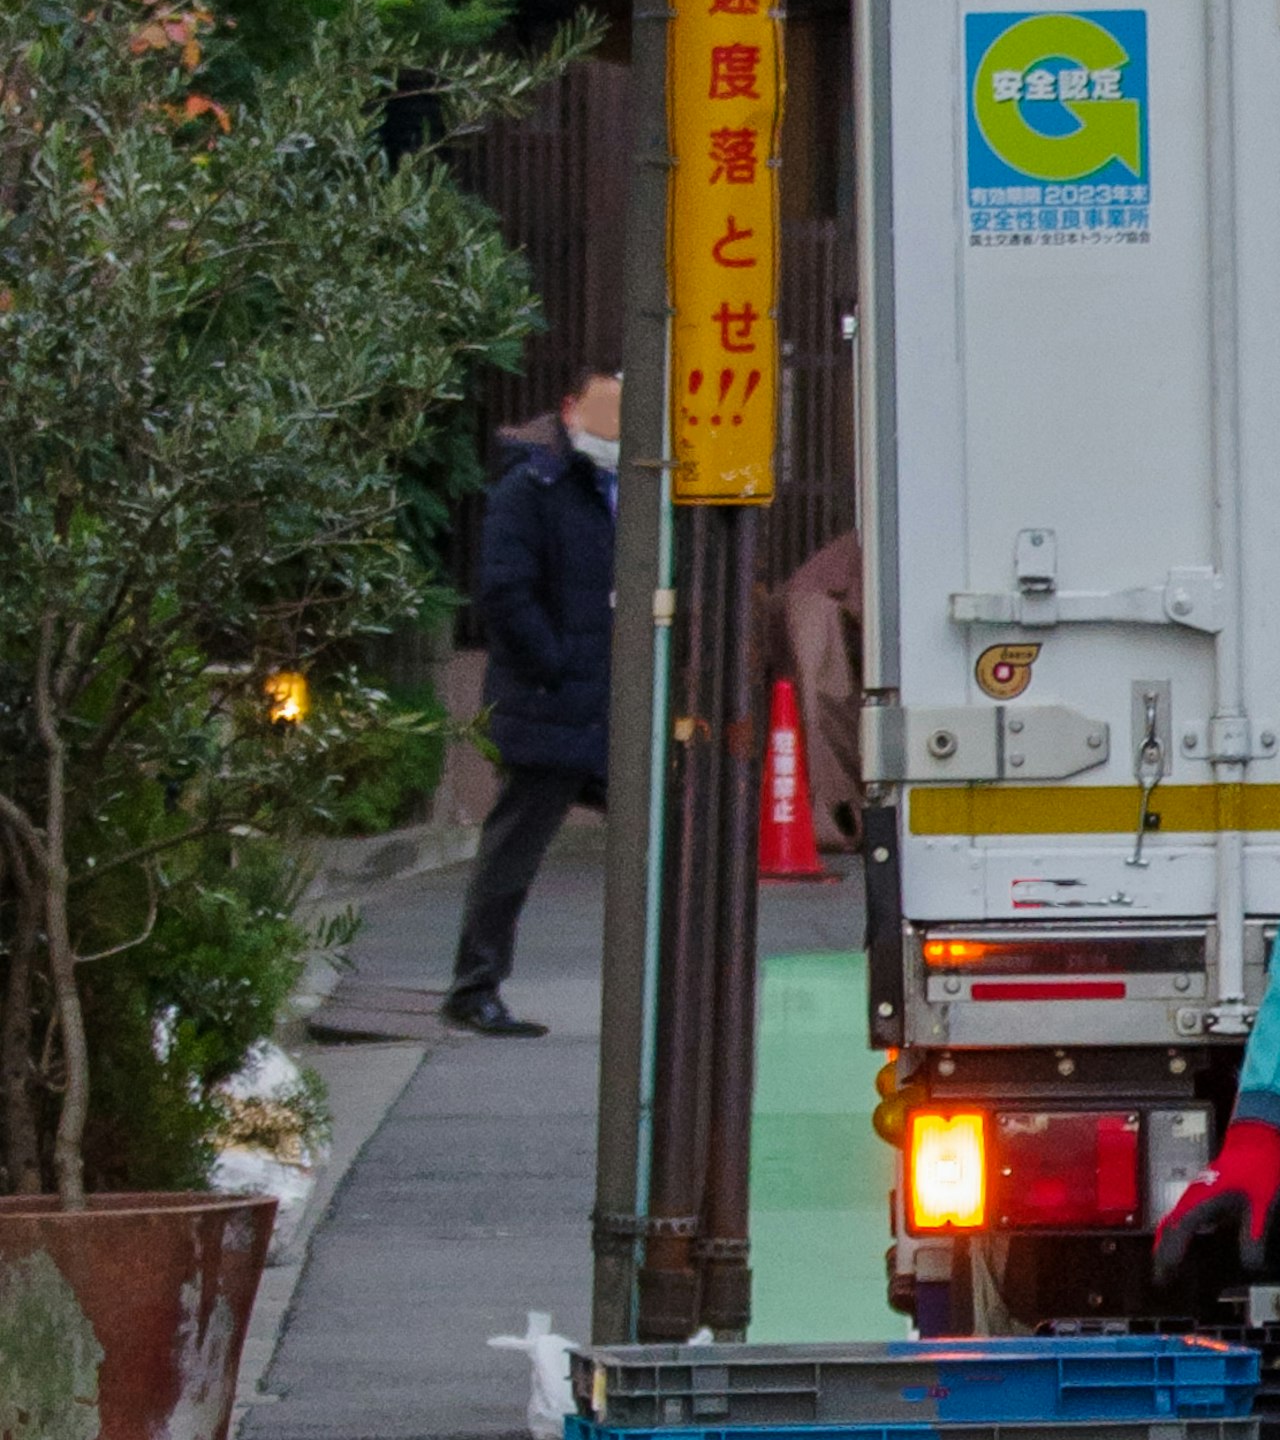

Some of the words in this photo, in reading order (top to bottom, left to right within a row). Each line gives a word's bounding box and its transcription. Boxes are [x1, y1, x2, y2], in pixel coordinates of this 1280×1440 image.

[992, 69, 1122, 102] 安全認定
[971, 208, 1149, 232] 安全性優良事業所
